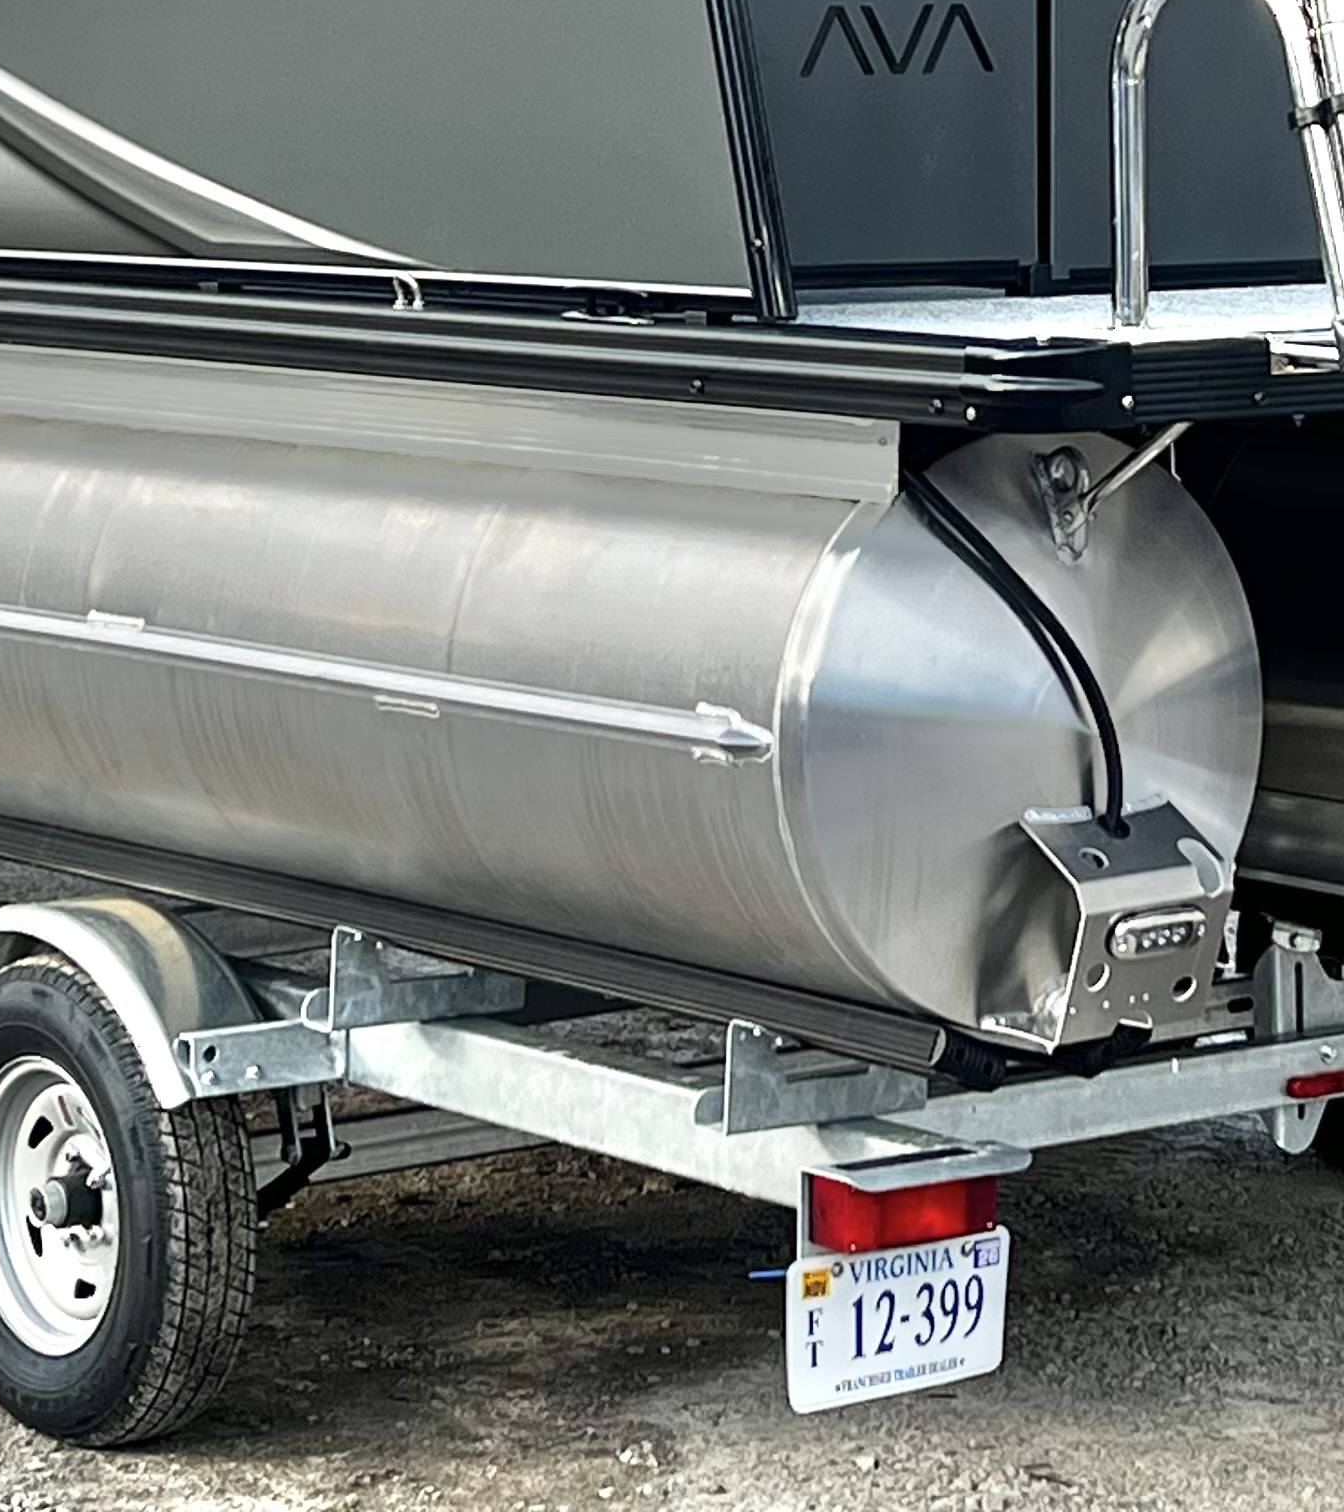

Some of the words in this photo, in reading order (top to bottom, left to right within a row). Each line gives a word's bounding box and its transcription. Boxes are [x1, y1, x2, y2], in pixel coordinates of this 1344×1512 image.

[799, 3, 994, 78] AVA
[849, 1247, 955, 1286] VIRGINIA
[851, 1274, 984, 1360] 12-399
